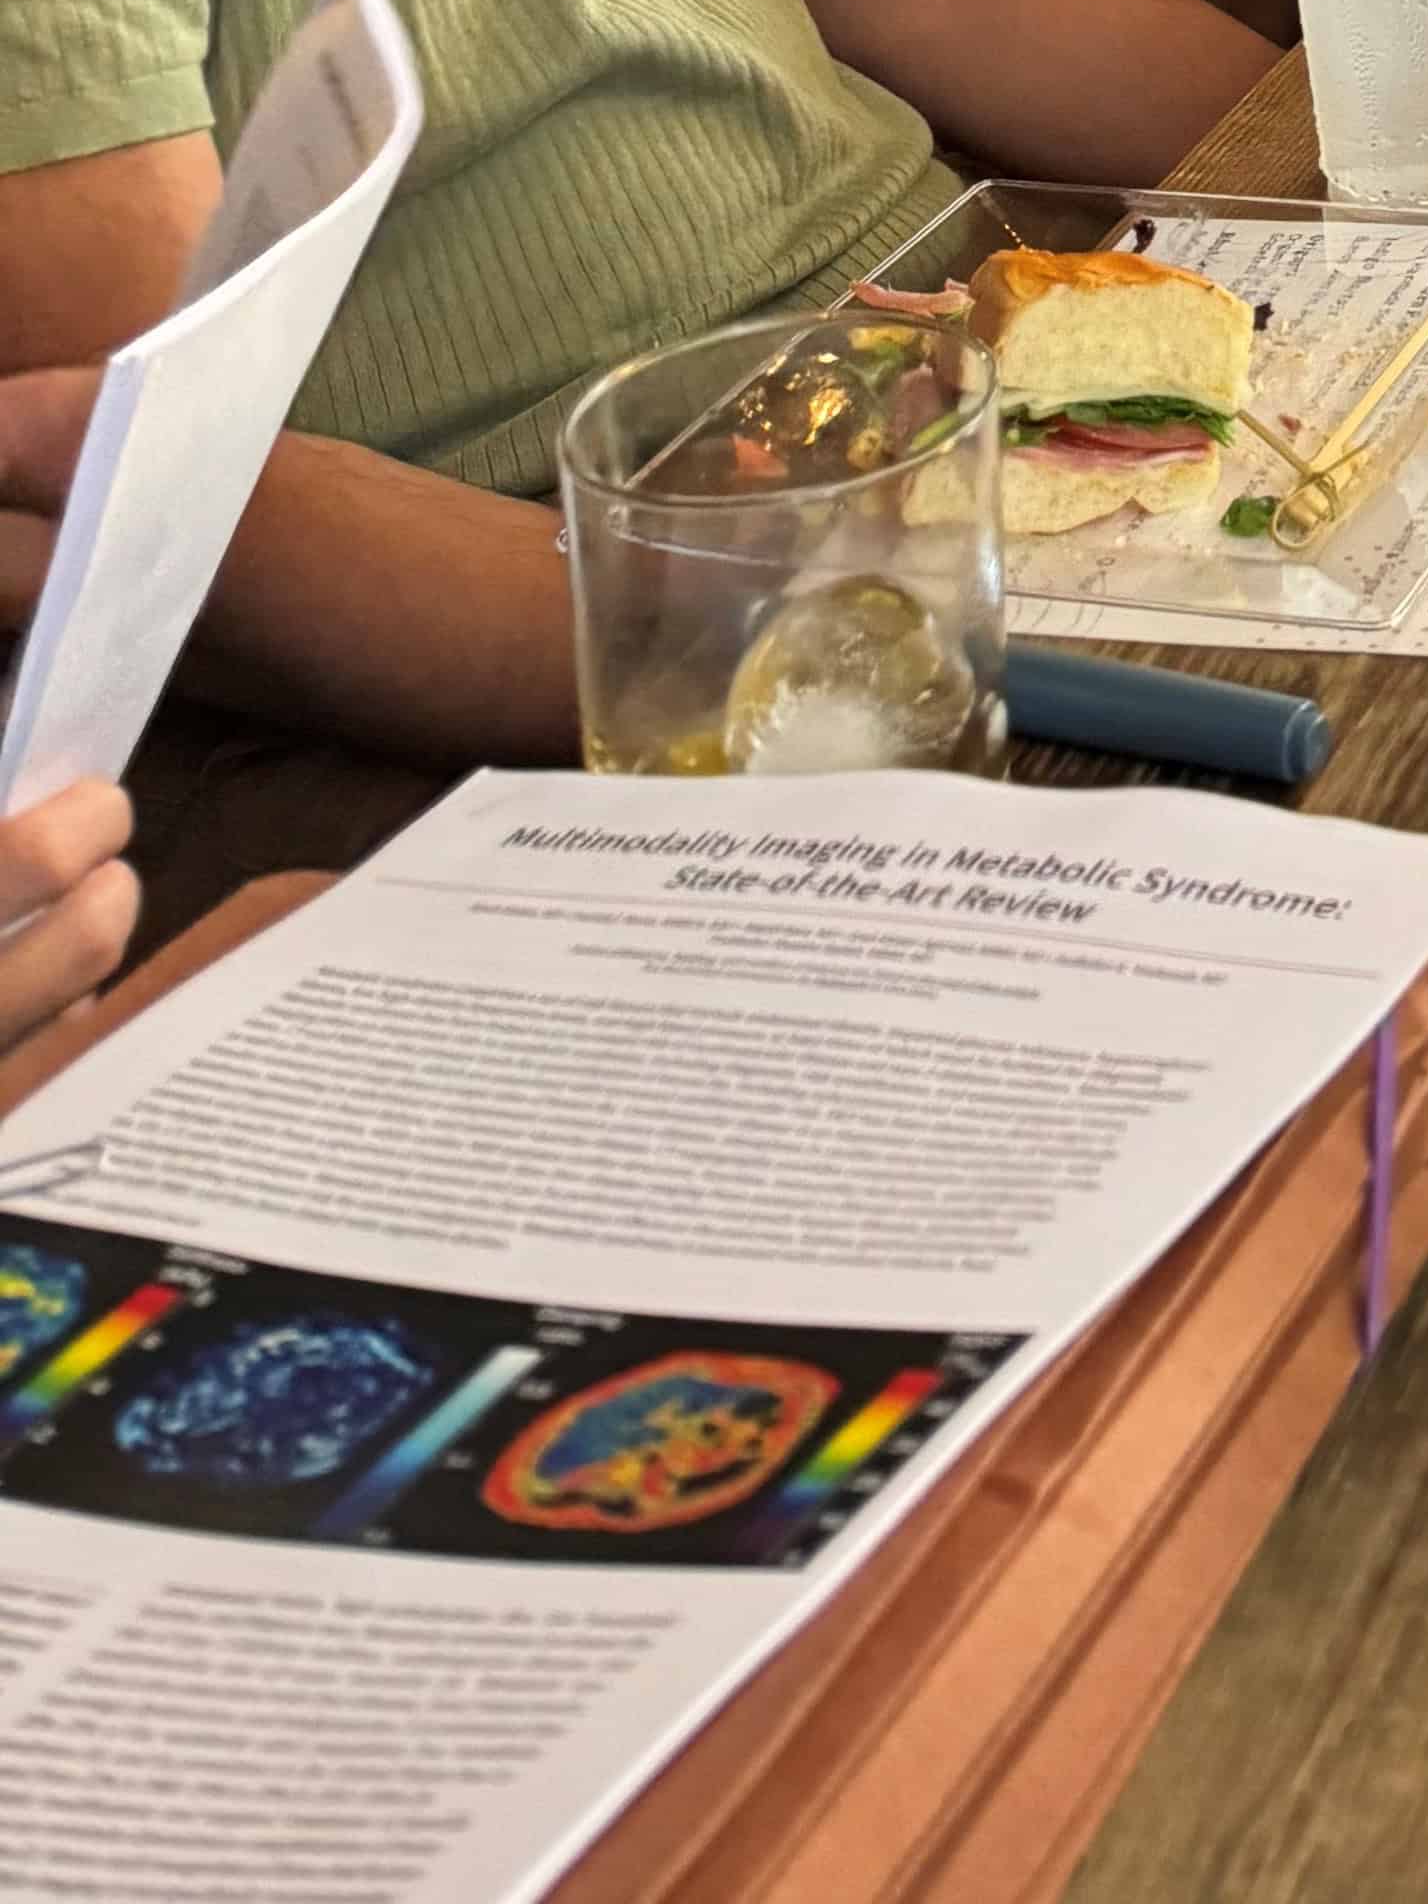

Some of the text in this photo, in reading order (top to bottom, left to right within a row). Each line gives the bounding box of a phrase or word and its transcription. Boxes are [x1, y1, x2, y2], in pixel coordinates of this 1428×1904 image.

[502, 823, 1356, 922] Multimodality Imaging in Metabolic Syndrome:
[665, 864, 1096, 926] State-of-the-Art Review
